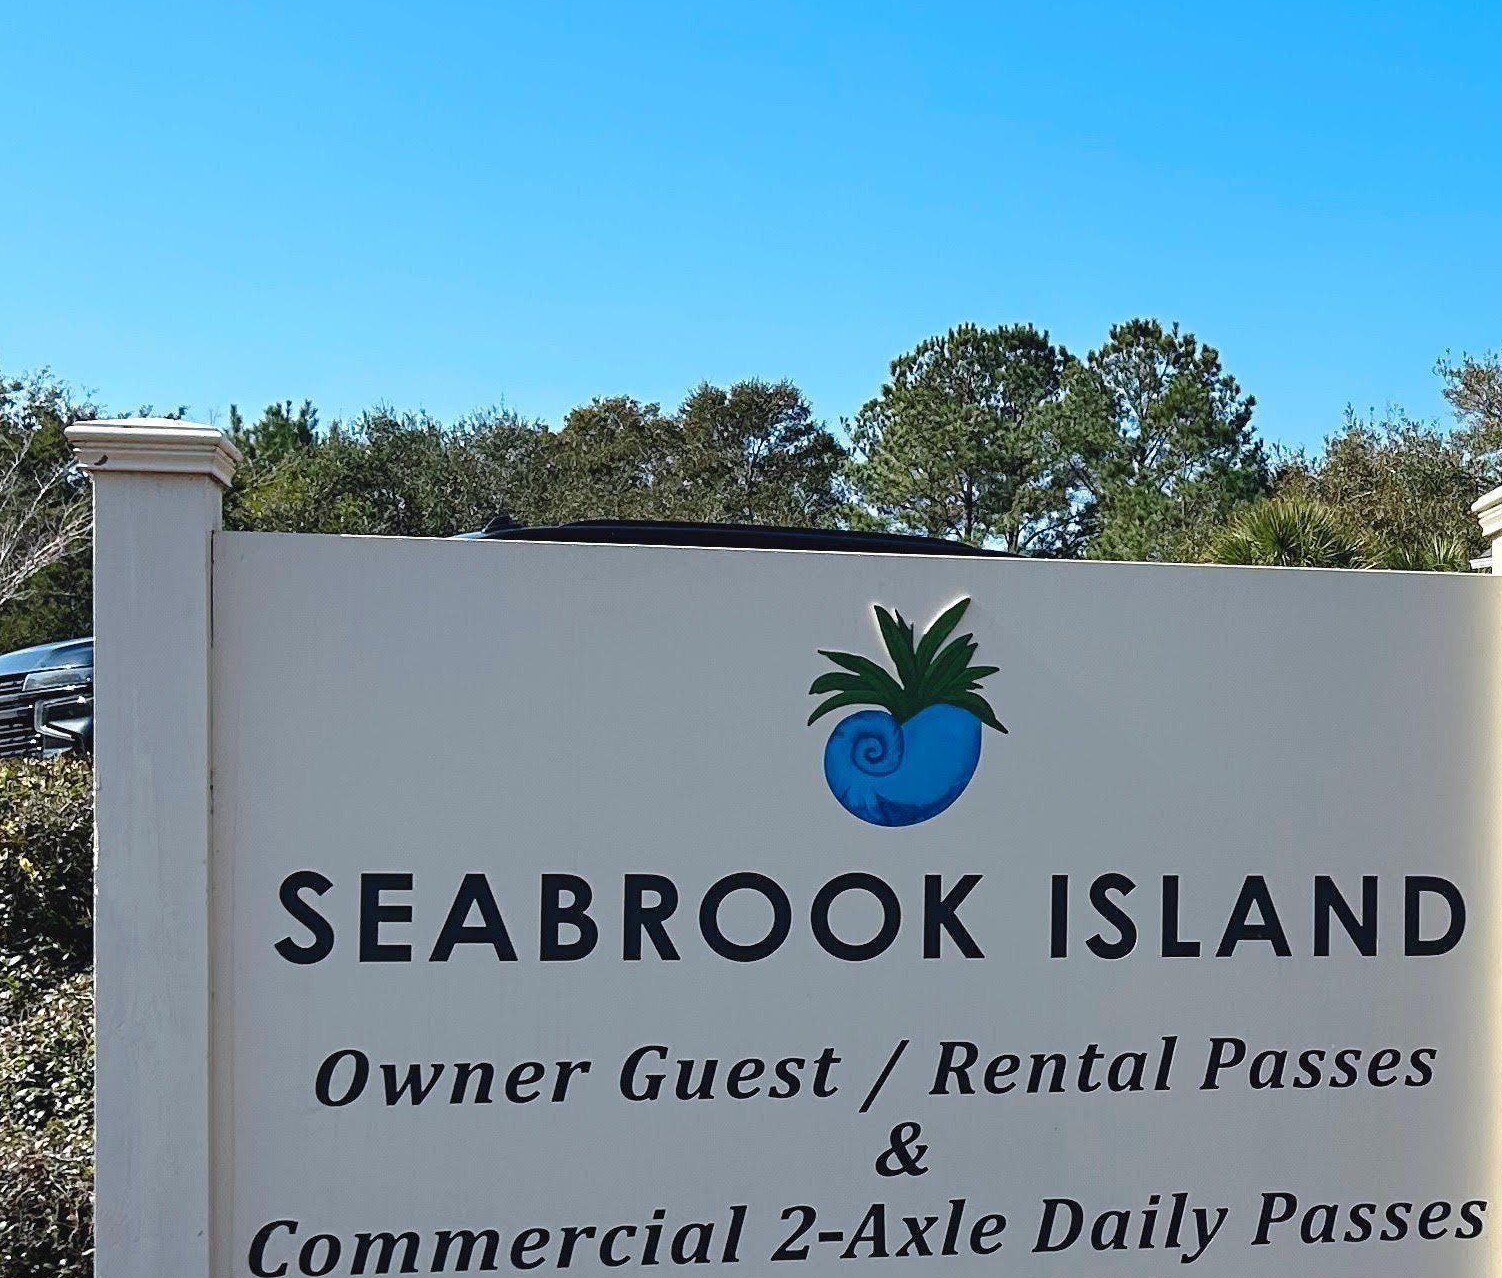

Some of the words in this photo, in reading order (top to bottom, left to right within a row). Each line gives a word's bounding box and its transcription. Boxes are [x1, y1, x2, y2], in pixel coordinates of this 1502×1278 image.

[273, 870, 986, 965] SEABROOK
[1050, 872, 1466, 960] ISLAND
[315, 1049, 592, 1107] Owner
[619, 1045, 842, 1102] Guest
[858, 1039, 910, 1114] /
[928, 1035, 1178, 1096] Rental
[1198, 1037, 1438, 1091] Passes
[875, 1121, 929, 1177] &
[247, 1204, 748, 1278] Commercial
[770, 1198, 1007, 1262] 2-Axle
[1031, 1192, 1229, 1264] Daily
[1250, 1192, 1488, 1246] Passes
